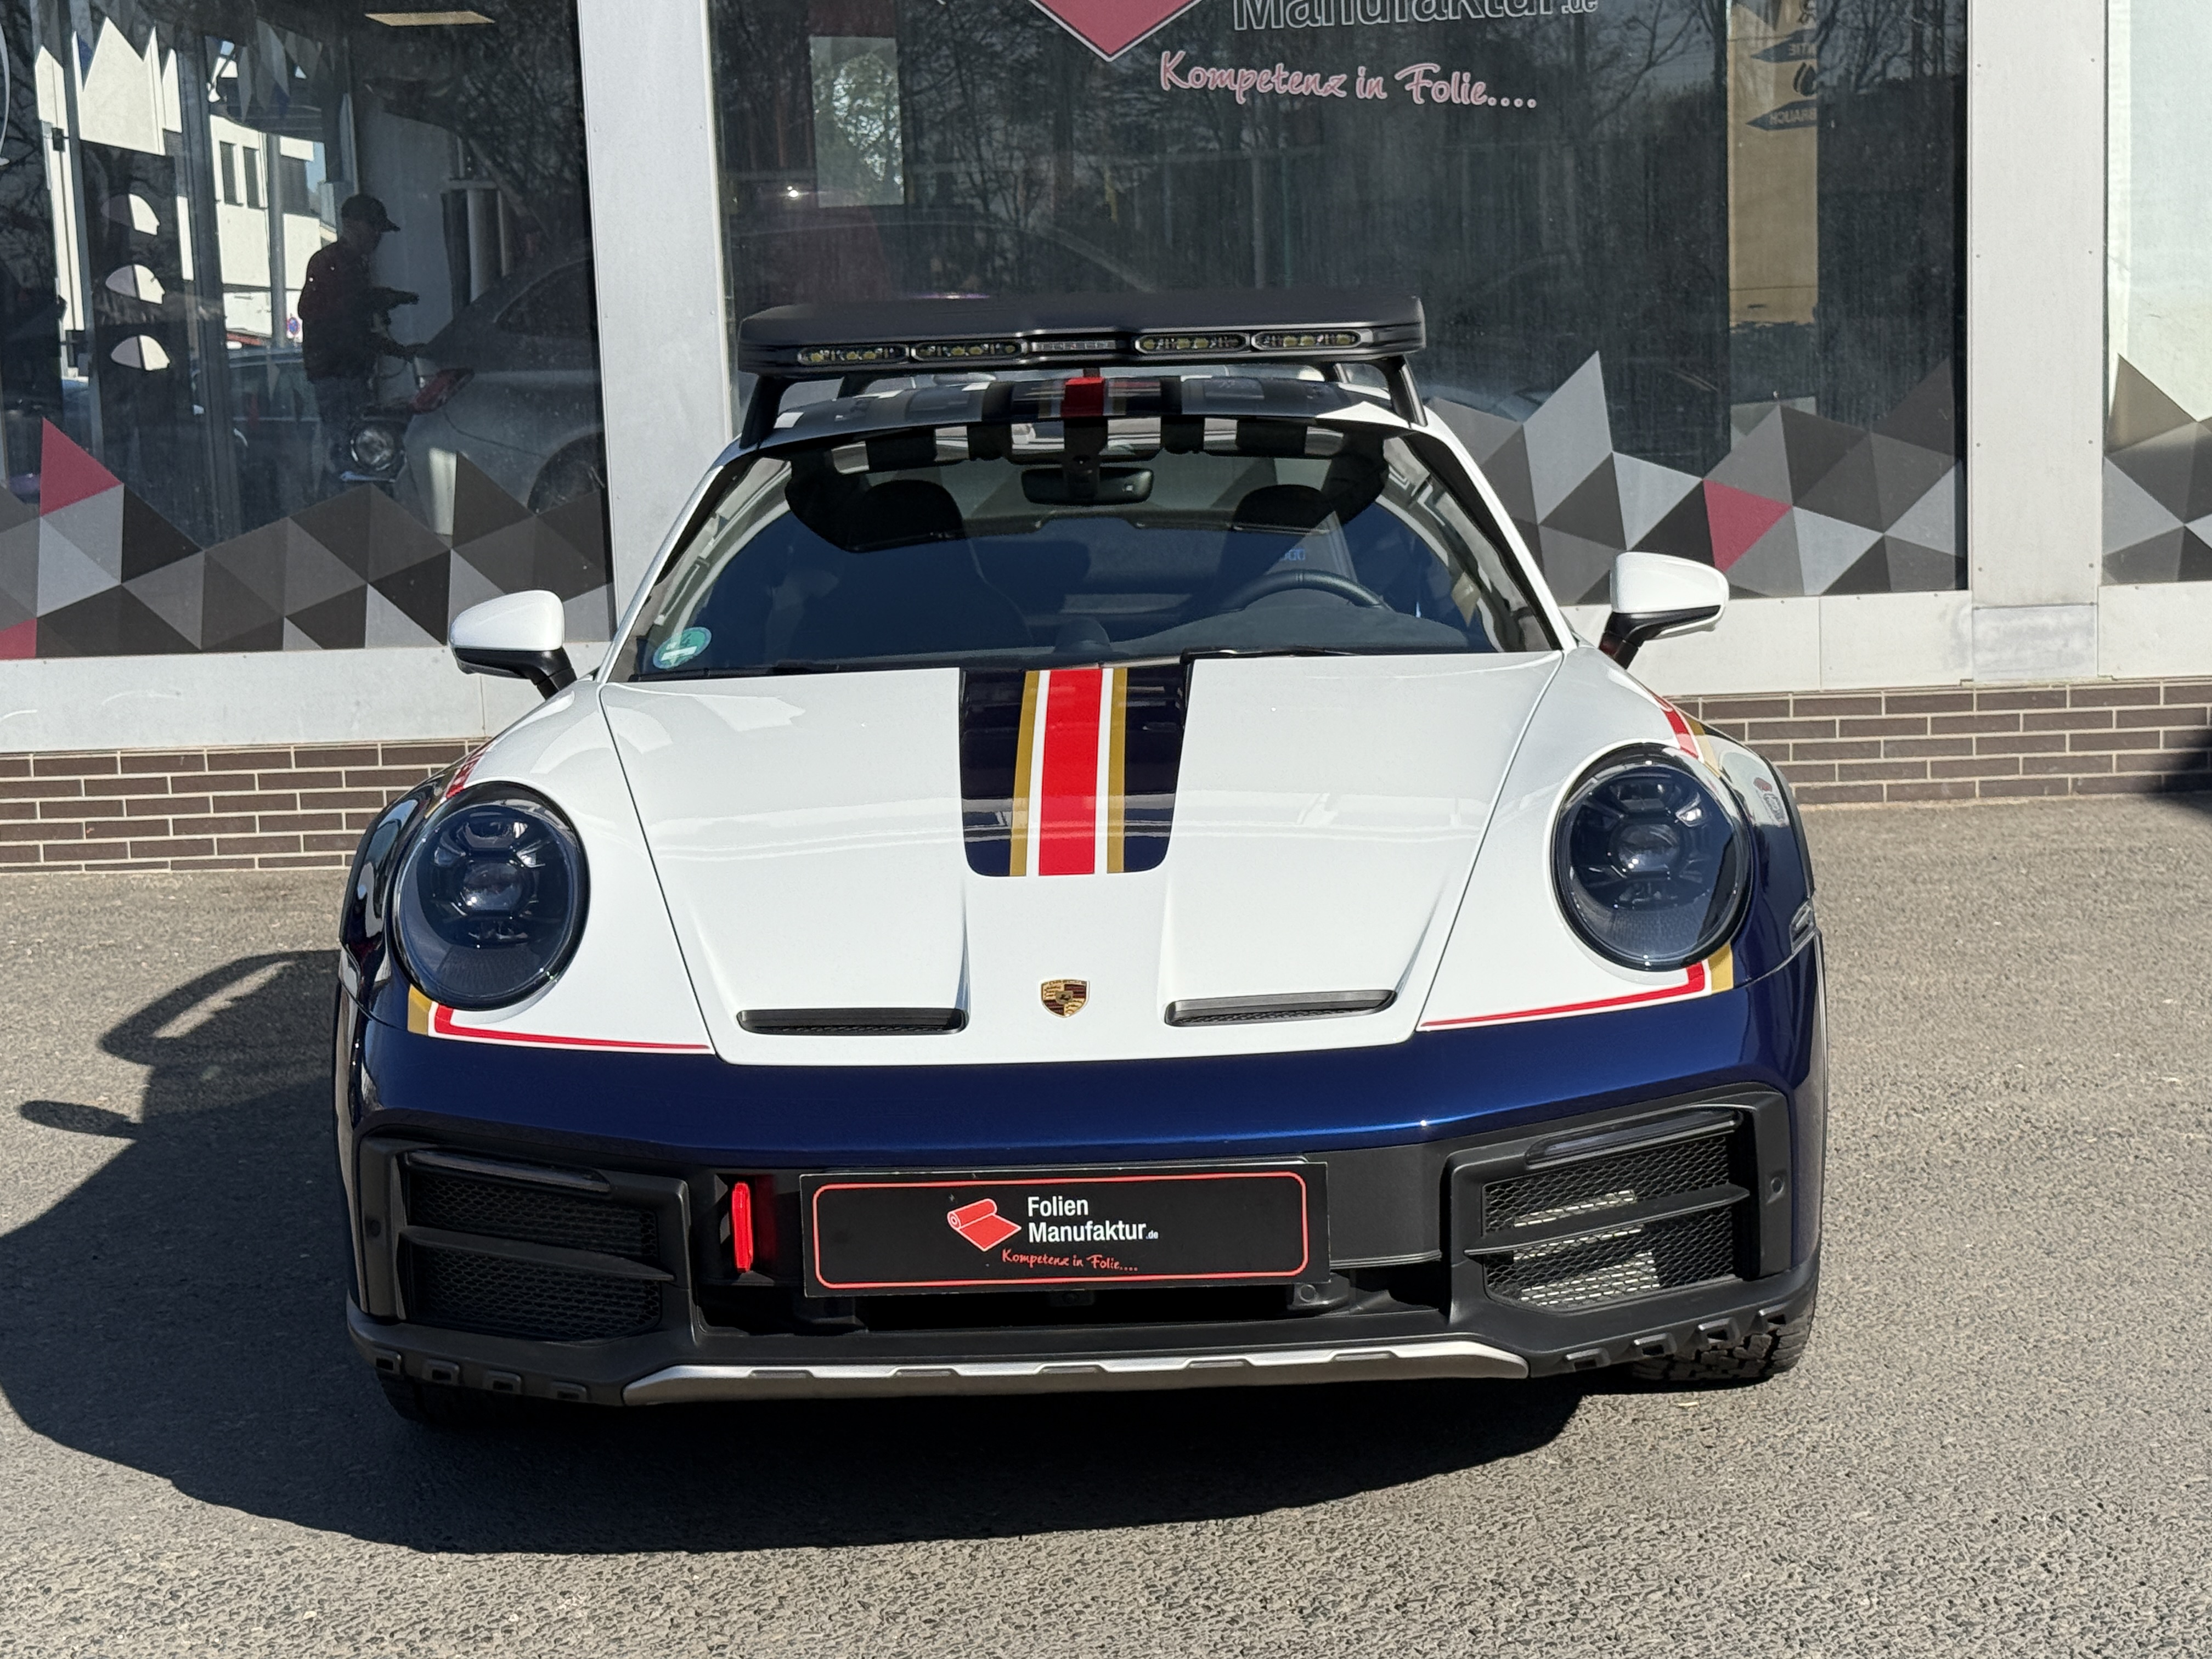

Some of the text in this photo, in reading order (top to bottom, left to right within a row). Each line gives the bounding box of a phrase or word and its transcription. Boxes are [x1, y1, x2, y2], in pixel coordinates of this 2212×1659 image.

[1160, 50, 1537, 109] Kompetenz in Folie....
[1028, 1195, 1089, 1217] Folien
[1029, 1220, 1159, 1243] Manufaktur.de
[1001, 1248, 1138, 1272] Kompetenz in Folie....
